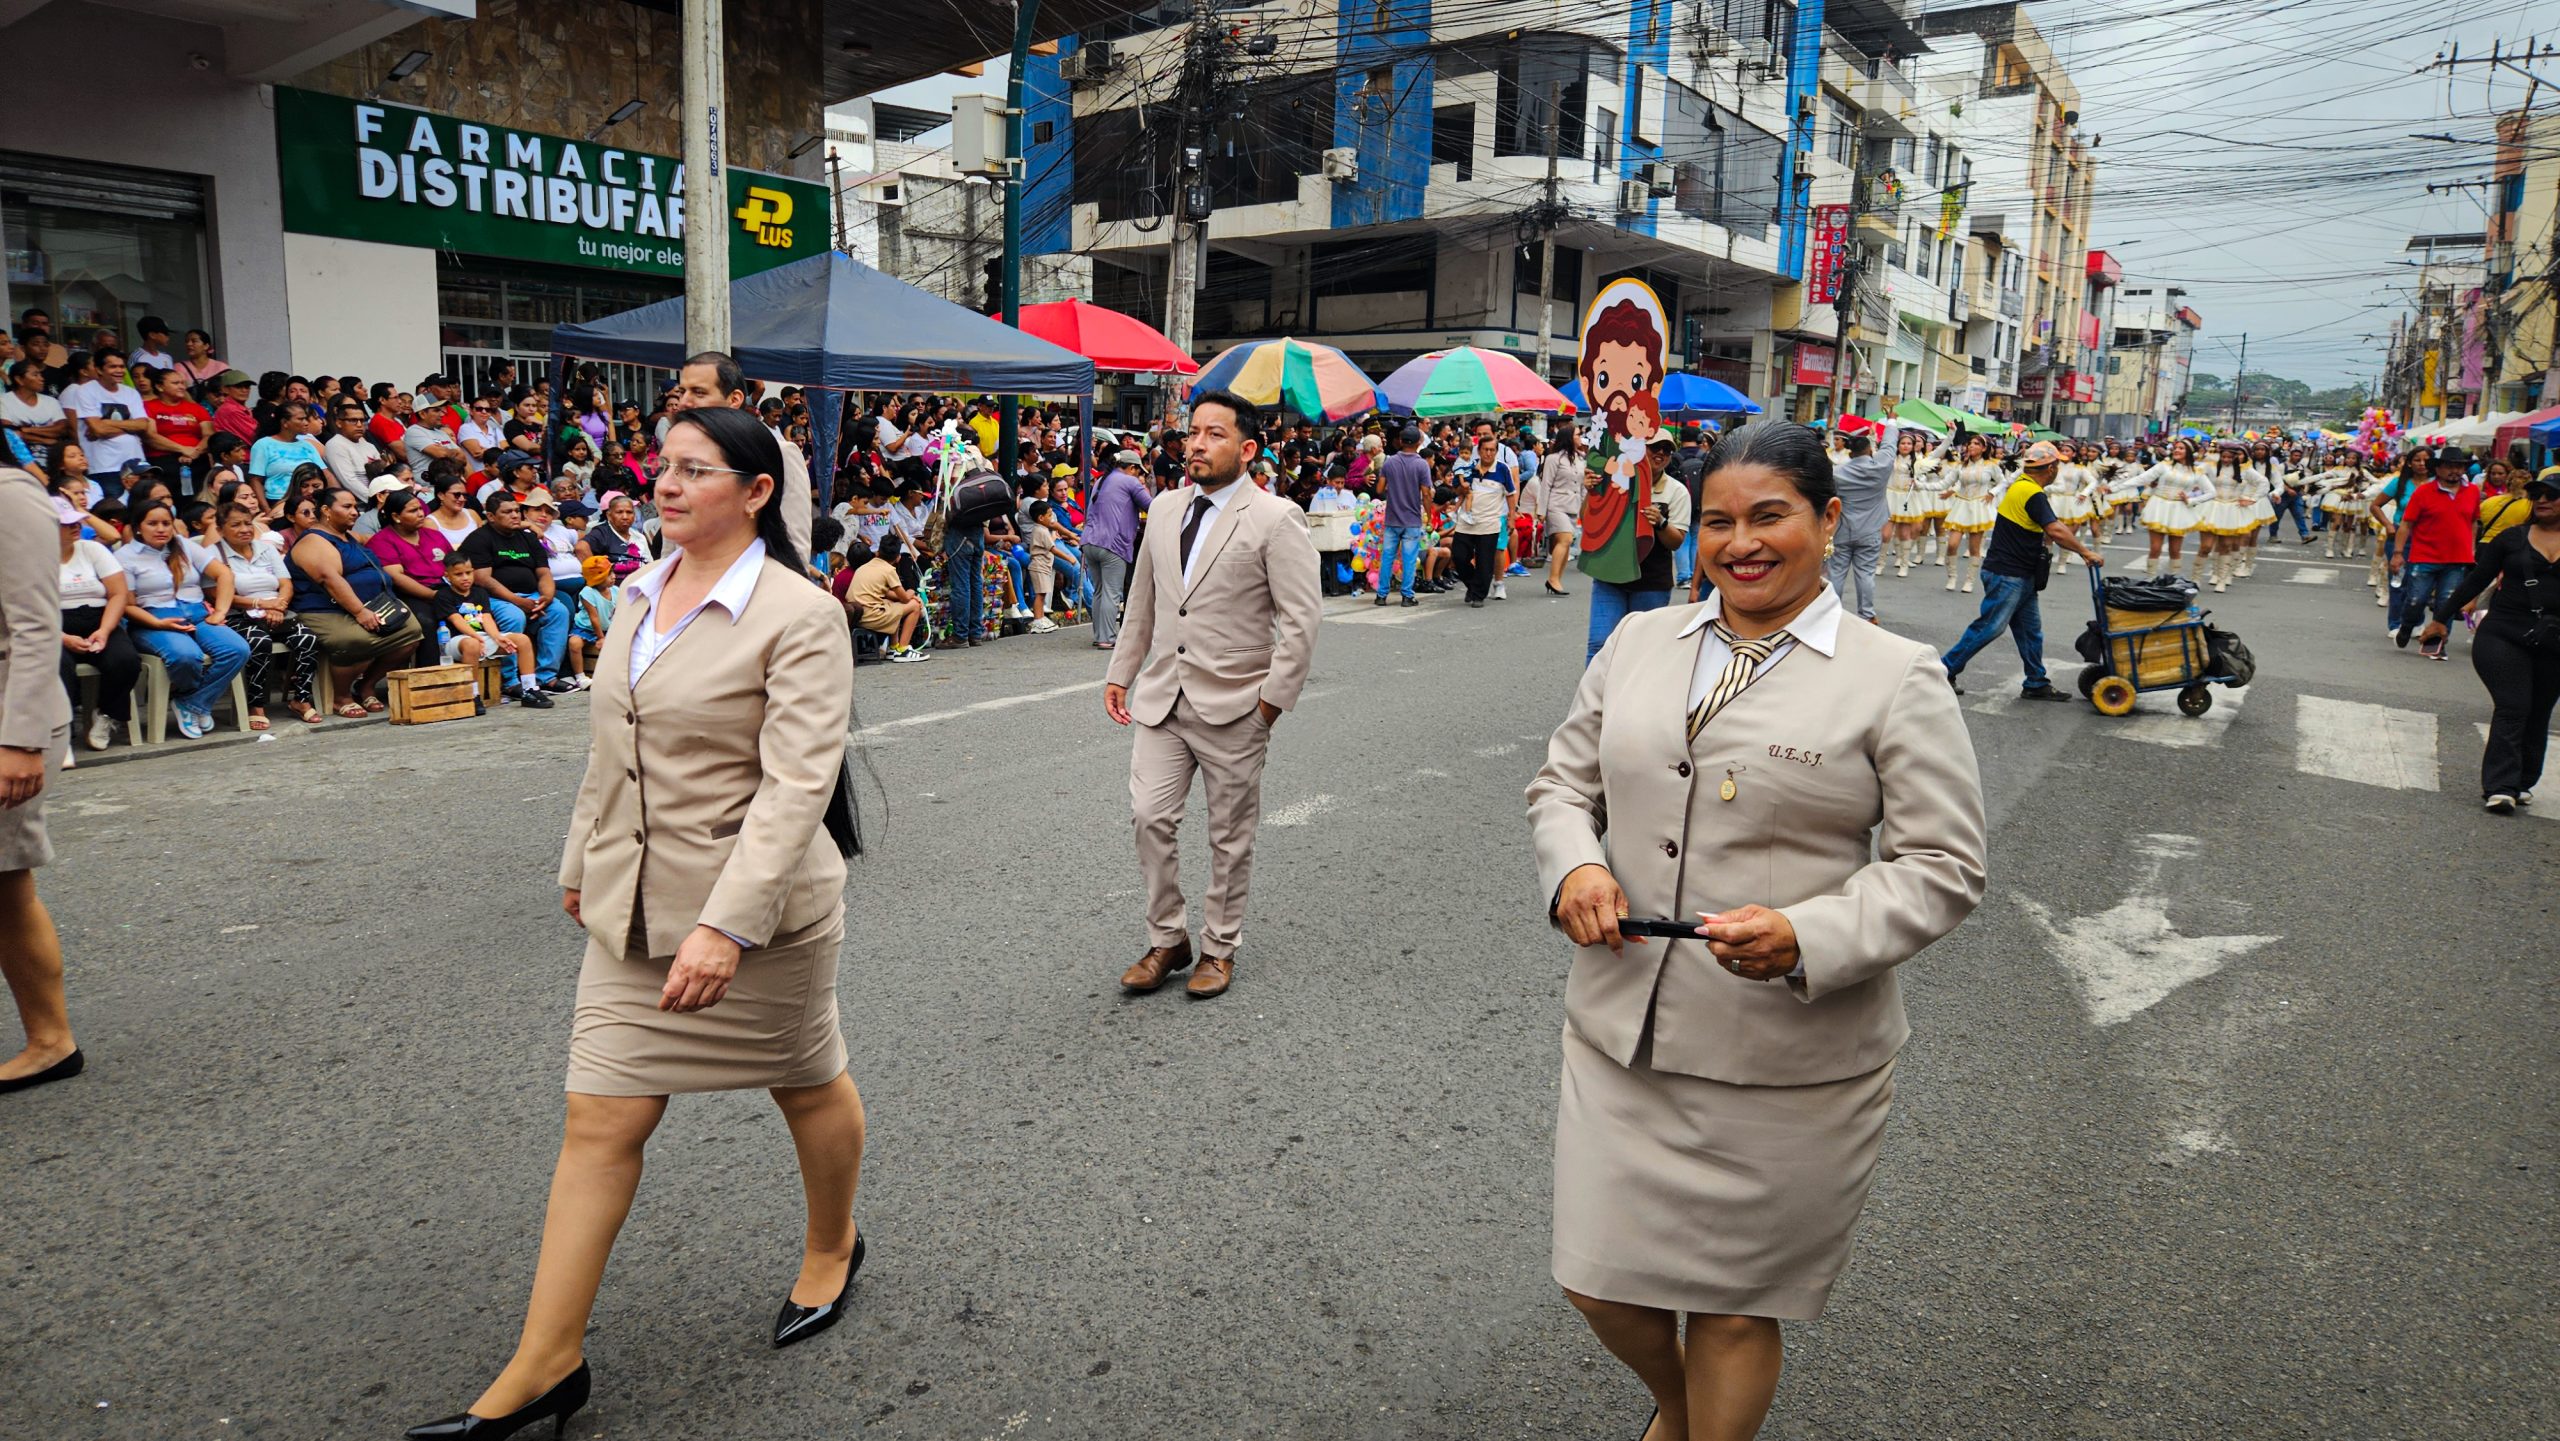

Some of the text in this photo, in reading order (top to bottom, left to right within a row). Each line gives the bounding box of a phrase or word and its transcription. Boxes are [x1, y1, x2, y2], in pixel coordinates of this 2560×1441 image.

[578, 236, 685, 266] tu mejor ele
[1812, 207, 1829, 302] farmacias
[1768, 744, 1823, 767] U.E.S.J.
